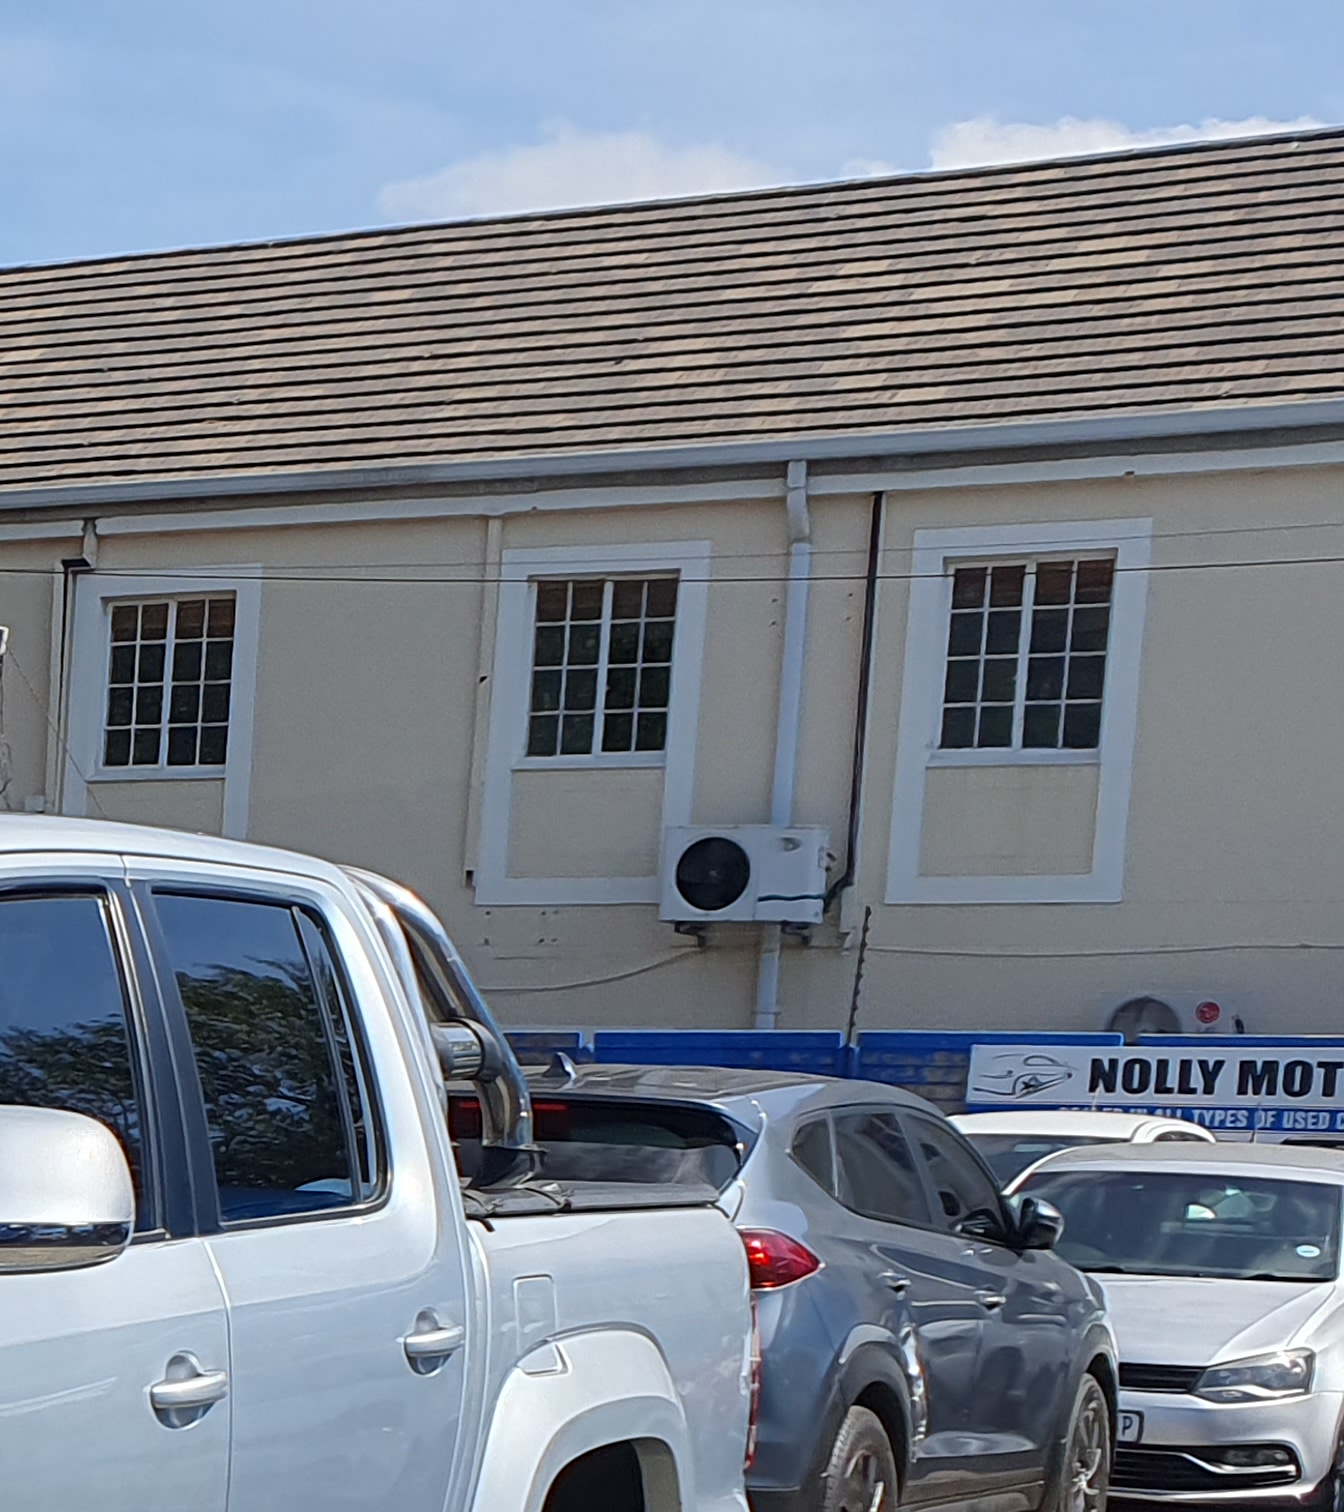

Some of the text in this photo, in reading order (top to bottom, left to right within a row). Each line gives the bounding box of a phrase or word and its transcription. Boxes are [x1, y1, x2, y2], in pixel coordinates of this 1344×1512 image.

[1088, 1057, 1225, 1096] NOLLY
[1191, 1109, 1248, 1128] TYPES
[1282, 1110, 1329, 1130] USED
